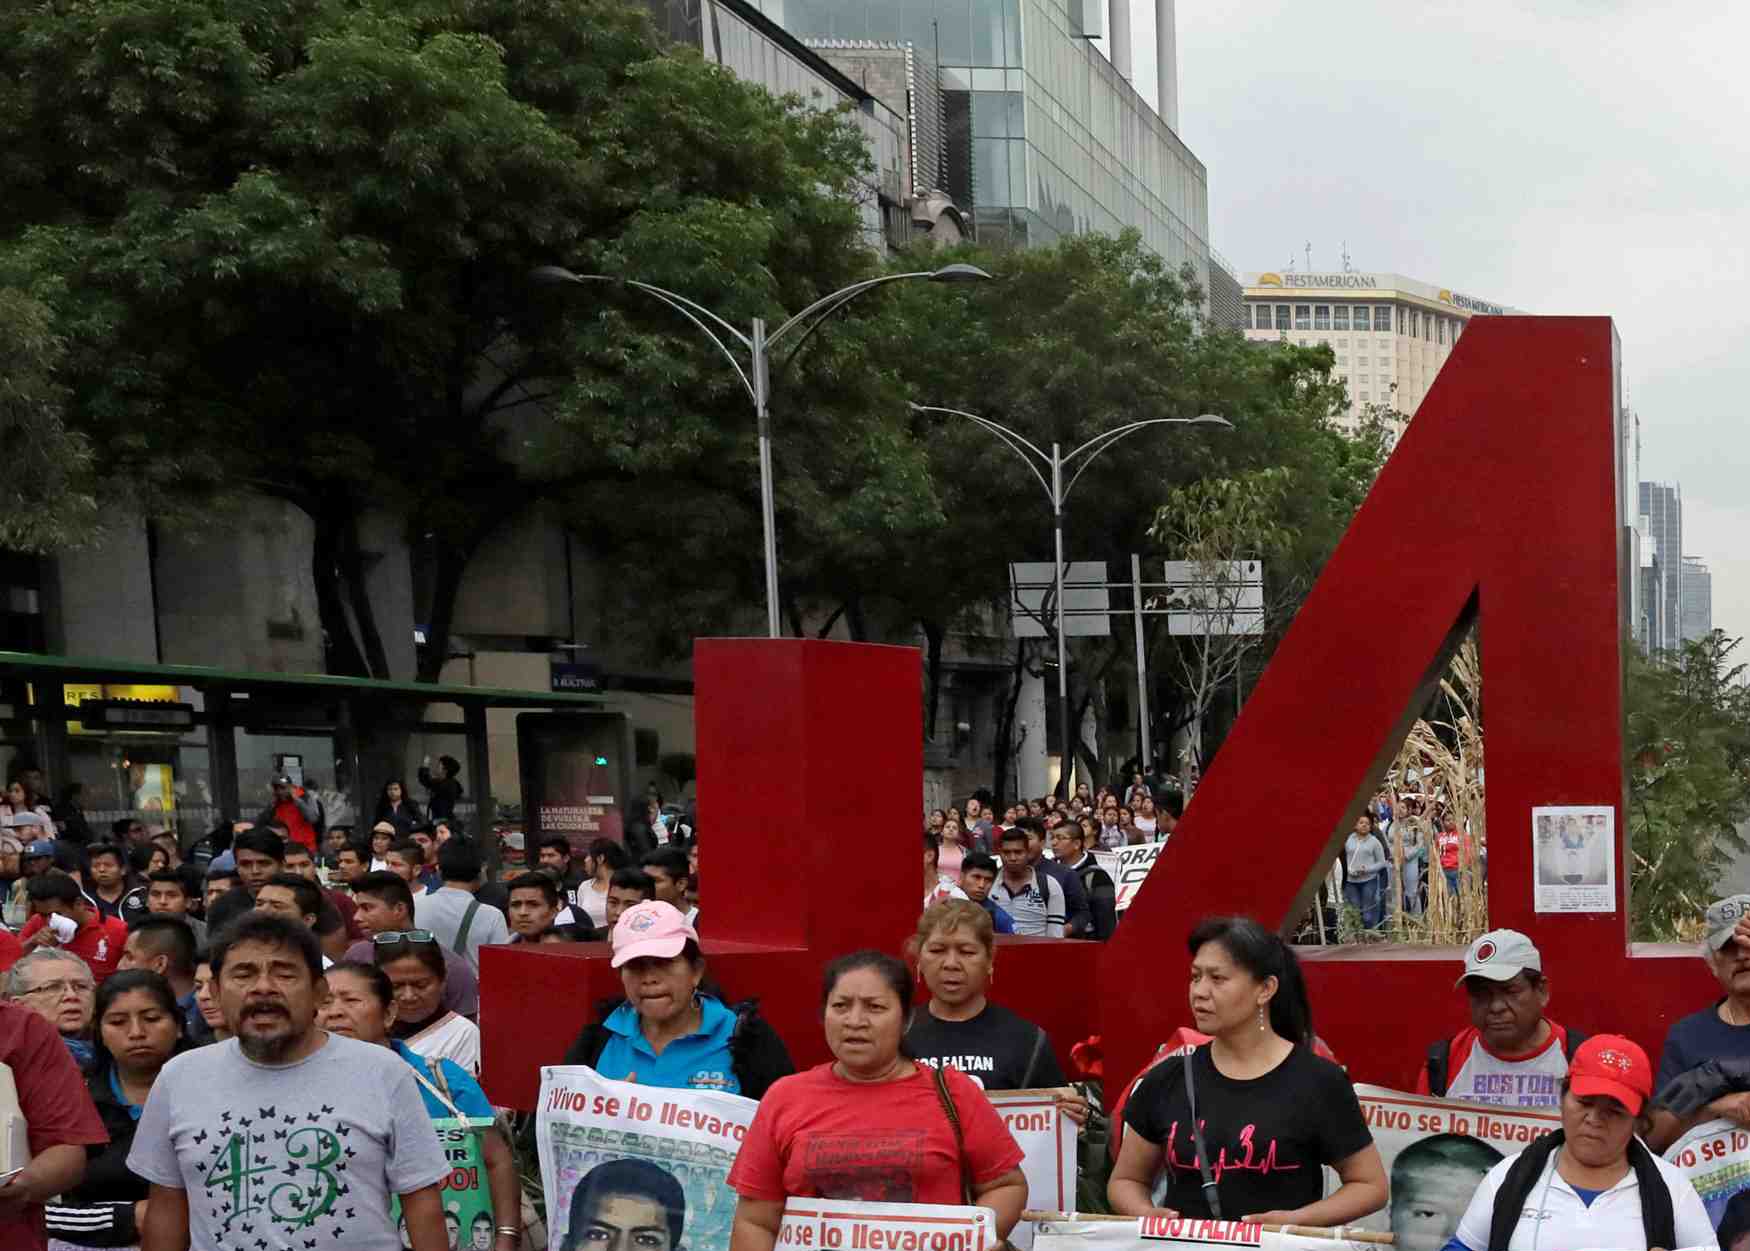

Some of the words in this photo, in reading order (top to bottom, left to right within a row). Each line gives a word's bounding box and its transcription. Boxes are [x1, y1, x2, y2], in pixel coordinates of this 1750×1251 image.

[592, 1095, 620, 1118] se
[627, 1096, 651, 1122] lo
[660, 1102, 752, 1145] llevaro
[1418, 1113, 1442, 1132] se
[1450, 1112, 1470, 1137] lo
[1700, 1139, 1727, 1161] se
[1730, 1131, 1749, 1152] lo
[204, 1127, 346, 1223] 43
[795, 1223, 813, 1246] se
[819, 1221, 843, 1249] lo
